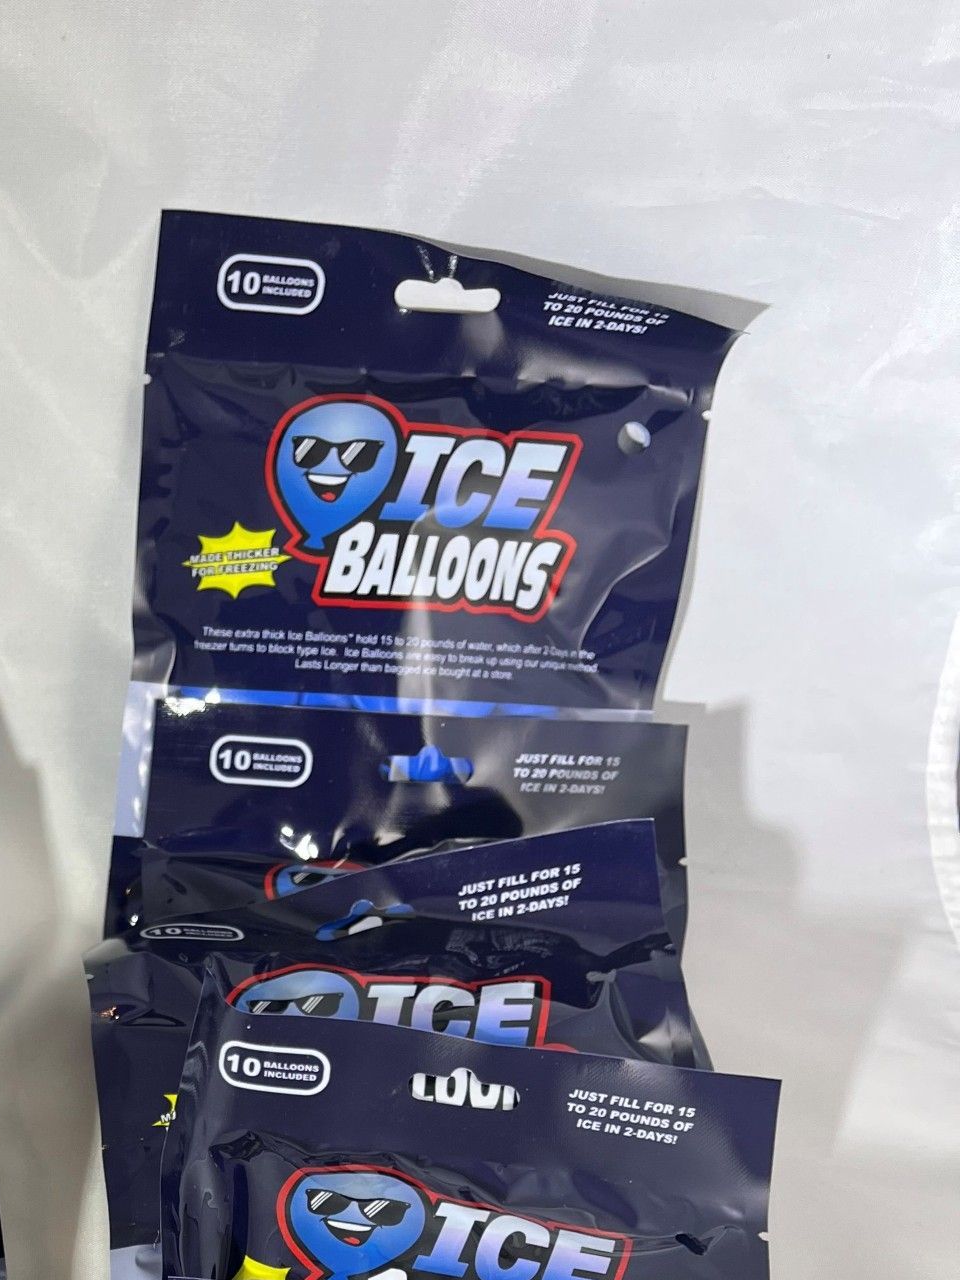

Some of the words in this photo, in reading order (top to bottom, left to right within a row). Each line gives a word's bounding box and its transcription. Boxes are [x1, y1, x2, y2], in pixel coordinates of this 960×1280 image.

[226, 271, 260, 296] 10
[262, 275, 315, 288] BALLOONS
[262, 285, 313, 299] INCLUDED
[548, 316, 575, 329] ICE
[576, 318, 594, 330] IN
[593, 320, 649, 335] 2-DAYS!
[380, 434, 568, 531] ICE
[190, 552, 223, 566] MADE
[226, 547, 280, 563] THICKER
[323, 521, 561, 610] BALLOONS
[192, 564, 218, 578] FOR
[219, 559, 279, 575] FREEZING
[218, 750, 250, 772] 10
[252, 753, 304, 765] BALLOONS
[252, 763, 302, 775] INCLUDED
[458, 879, 496, 897] JUST
[497, 873, 528, 889] FILL
[530, 867, 561, 883] FOR
[563, 863, 581, 876] 15
[458, 898, 478, 911] TO
[480, 893, 498, 907] 20
[500, 881, 559, 903] POUNDS
[561, 877, 582, 891] OF
[471, 908, 495, 922] ICE
[498, 905, 514, 918] IN
[516, 895, 570, 915] 2-DAYS!
[227, 1054, 262, 1077] 10
[264, 1061, 320, 1074] BALLOONS
[264, 1071, 318, 1083] INCLUDED
[568, 1089, 609, 1104] JUST
[609, 1095, 641, 1110] FILL
[643, 1101, 675, 1115] FOR
[678, 1106, 696, 1118] 15
[566, 1102, 587, 1114] TO
[588, 1106, 607, 1118] 20
[609, 1109, 670, 1129] POUNDS
[672, 1120, 695, 1132] OF
[576, 1118, 602, 1132] ICE
[604, 1123, 621, 1135] IN
[623, 1126, 678, 1145] 2-DAYS!
